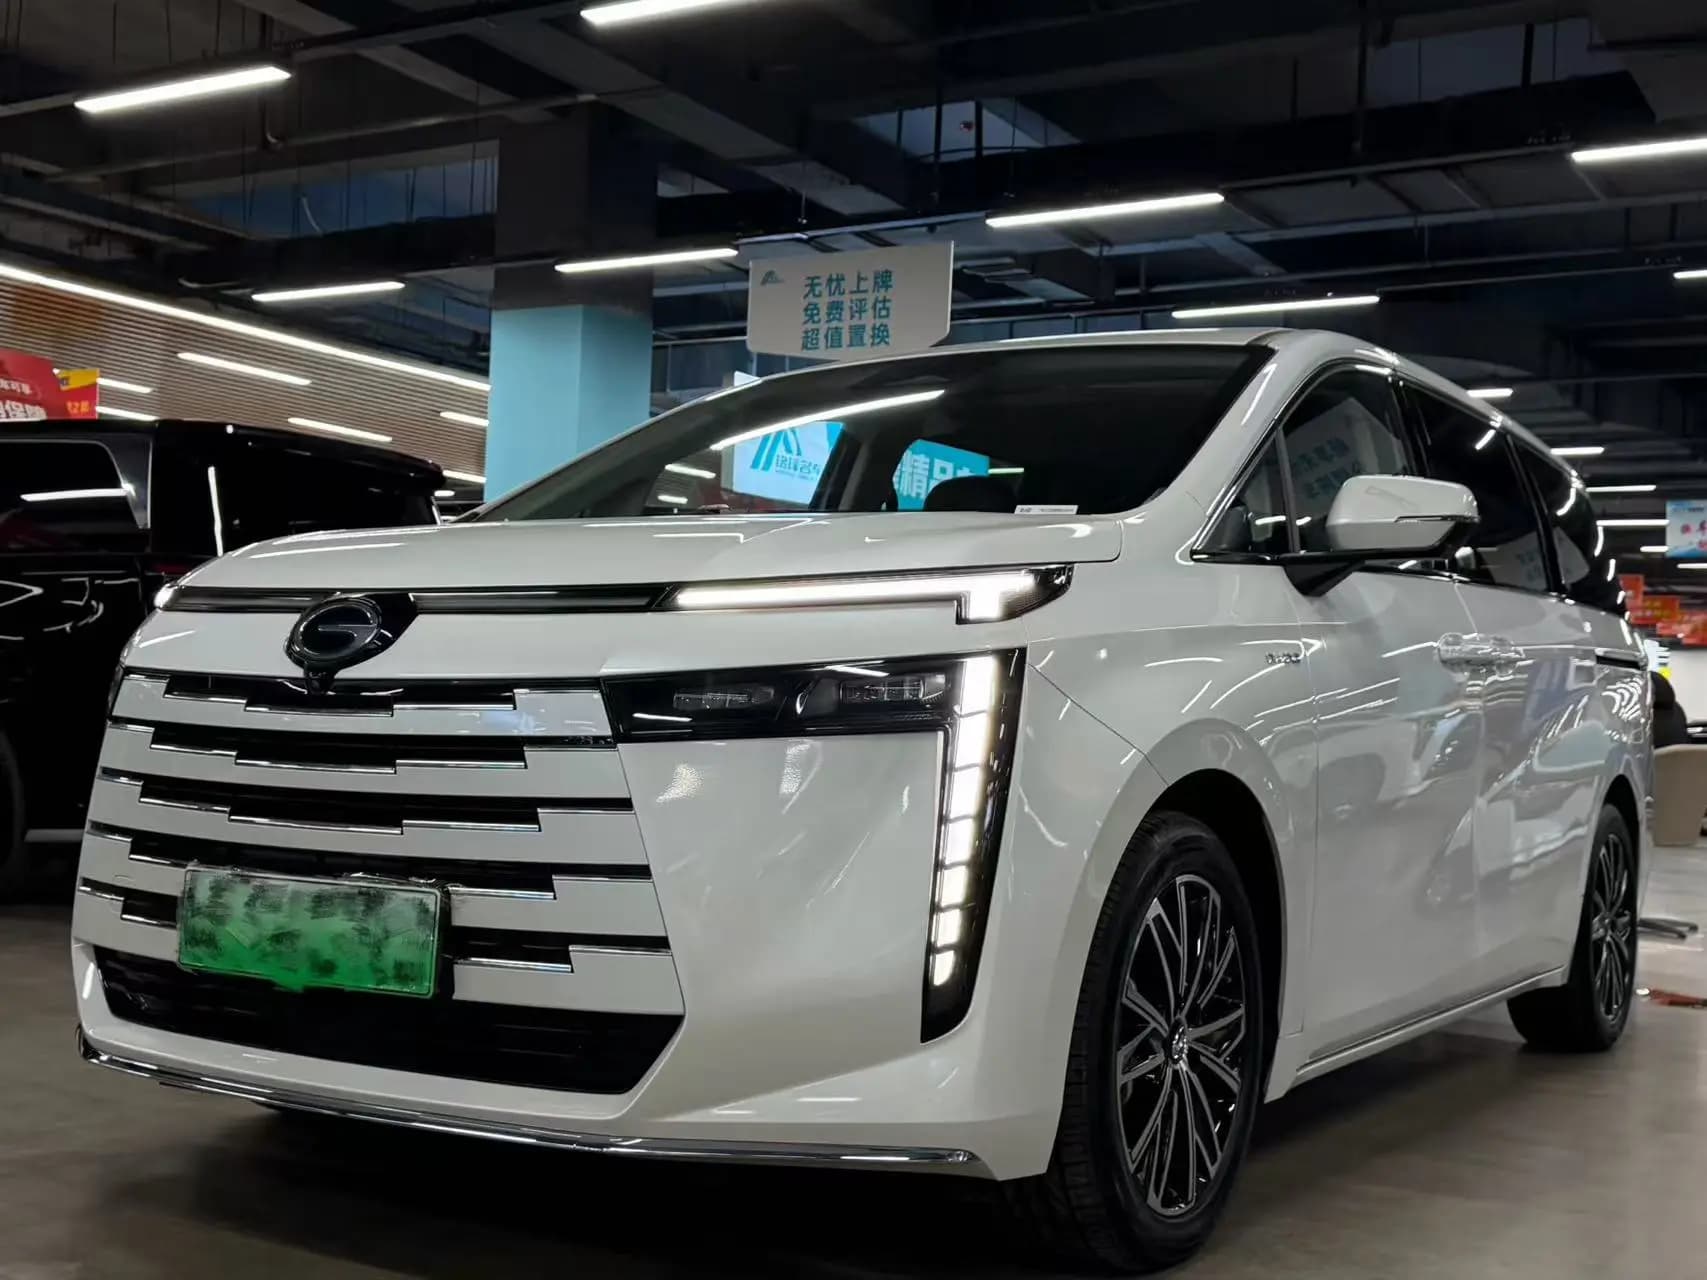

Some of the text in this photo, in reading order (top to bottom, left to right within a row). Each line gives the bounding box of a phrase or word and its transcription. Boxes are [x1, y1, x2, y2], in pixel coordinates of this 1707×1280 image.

[803, 269, 893, 299] 无忧上牌
[802, 297, 892, 325] 免费评估
[801, 323, 890, 351] 超值置换
[893, 449, 976, 498] 精品
